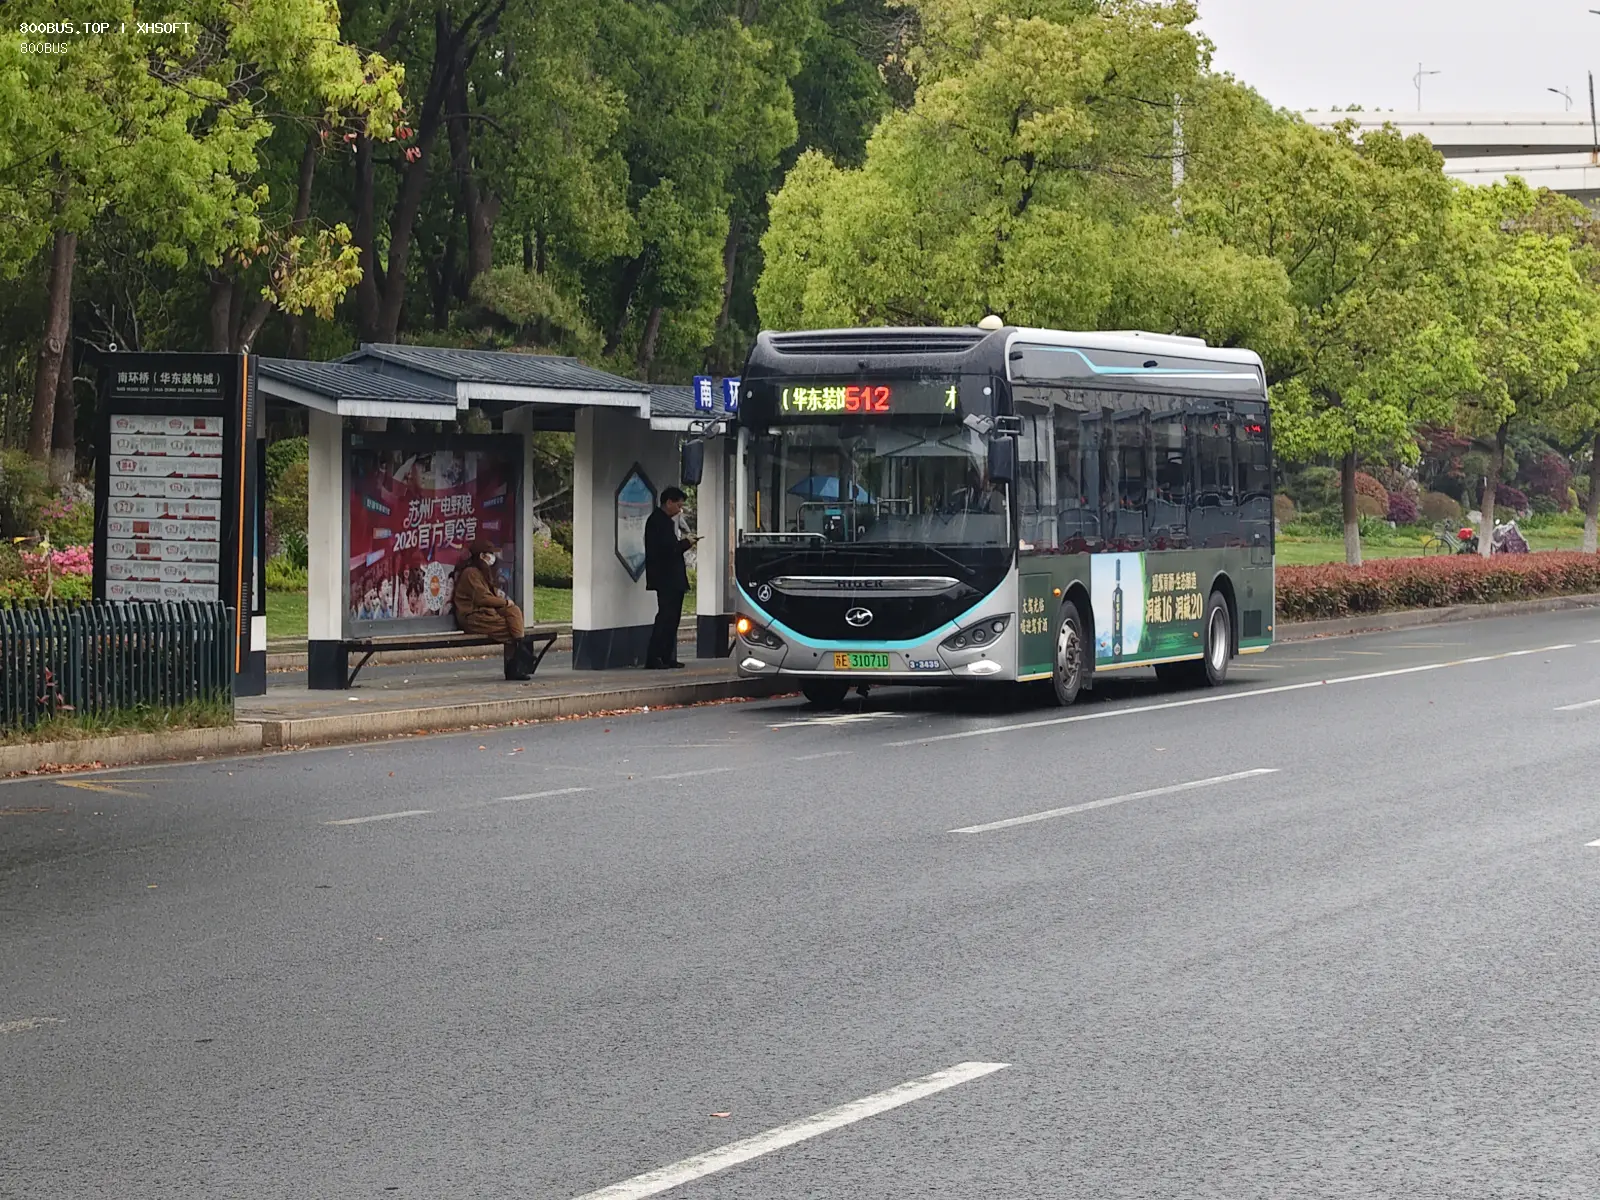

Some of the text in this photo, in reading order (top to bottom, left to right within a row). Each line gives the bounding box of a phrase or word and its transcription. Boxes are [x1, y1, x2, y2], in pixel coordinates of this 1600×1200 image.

[845, 386, 890, 411] 512
[403, 492, 475, 528] 苏州广电野狼
[393, 517, 478, 553] 2026官方夏令营
[1145, 595, 1172, 623] 洞藏16
[1175, 593, 1203, 620] 洞藏20
